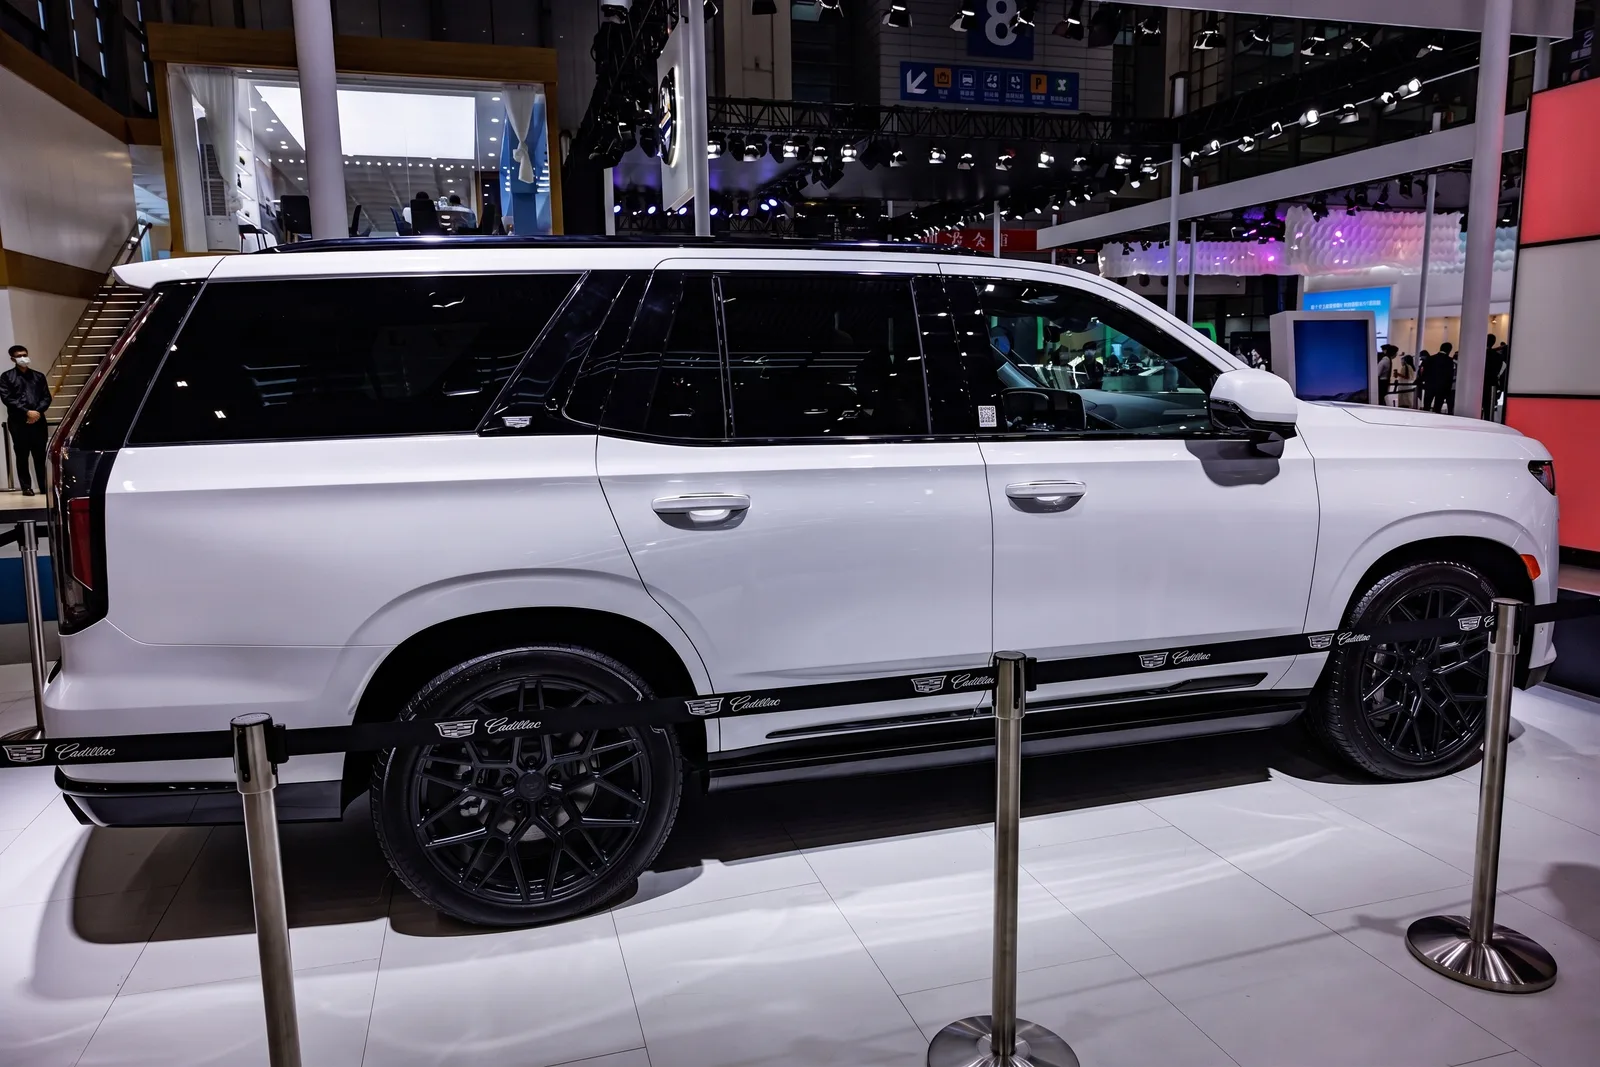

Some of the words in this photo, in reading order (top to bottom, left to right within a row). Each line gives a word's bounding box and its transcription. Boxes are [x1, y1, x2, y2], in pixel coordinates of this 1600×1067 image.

[985, 0, 1017, 46] 8
[1337, 631, 1371, 646] Cadillac
[1172, 650, 1211, 665] Cadillac
[729, 695, 781, 712] Cadillac
[484, 717, 542, 735] Cadillac
[54, 743, 116, 761] Cadillac
